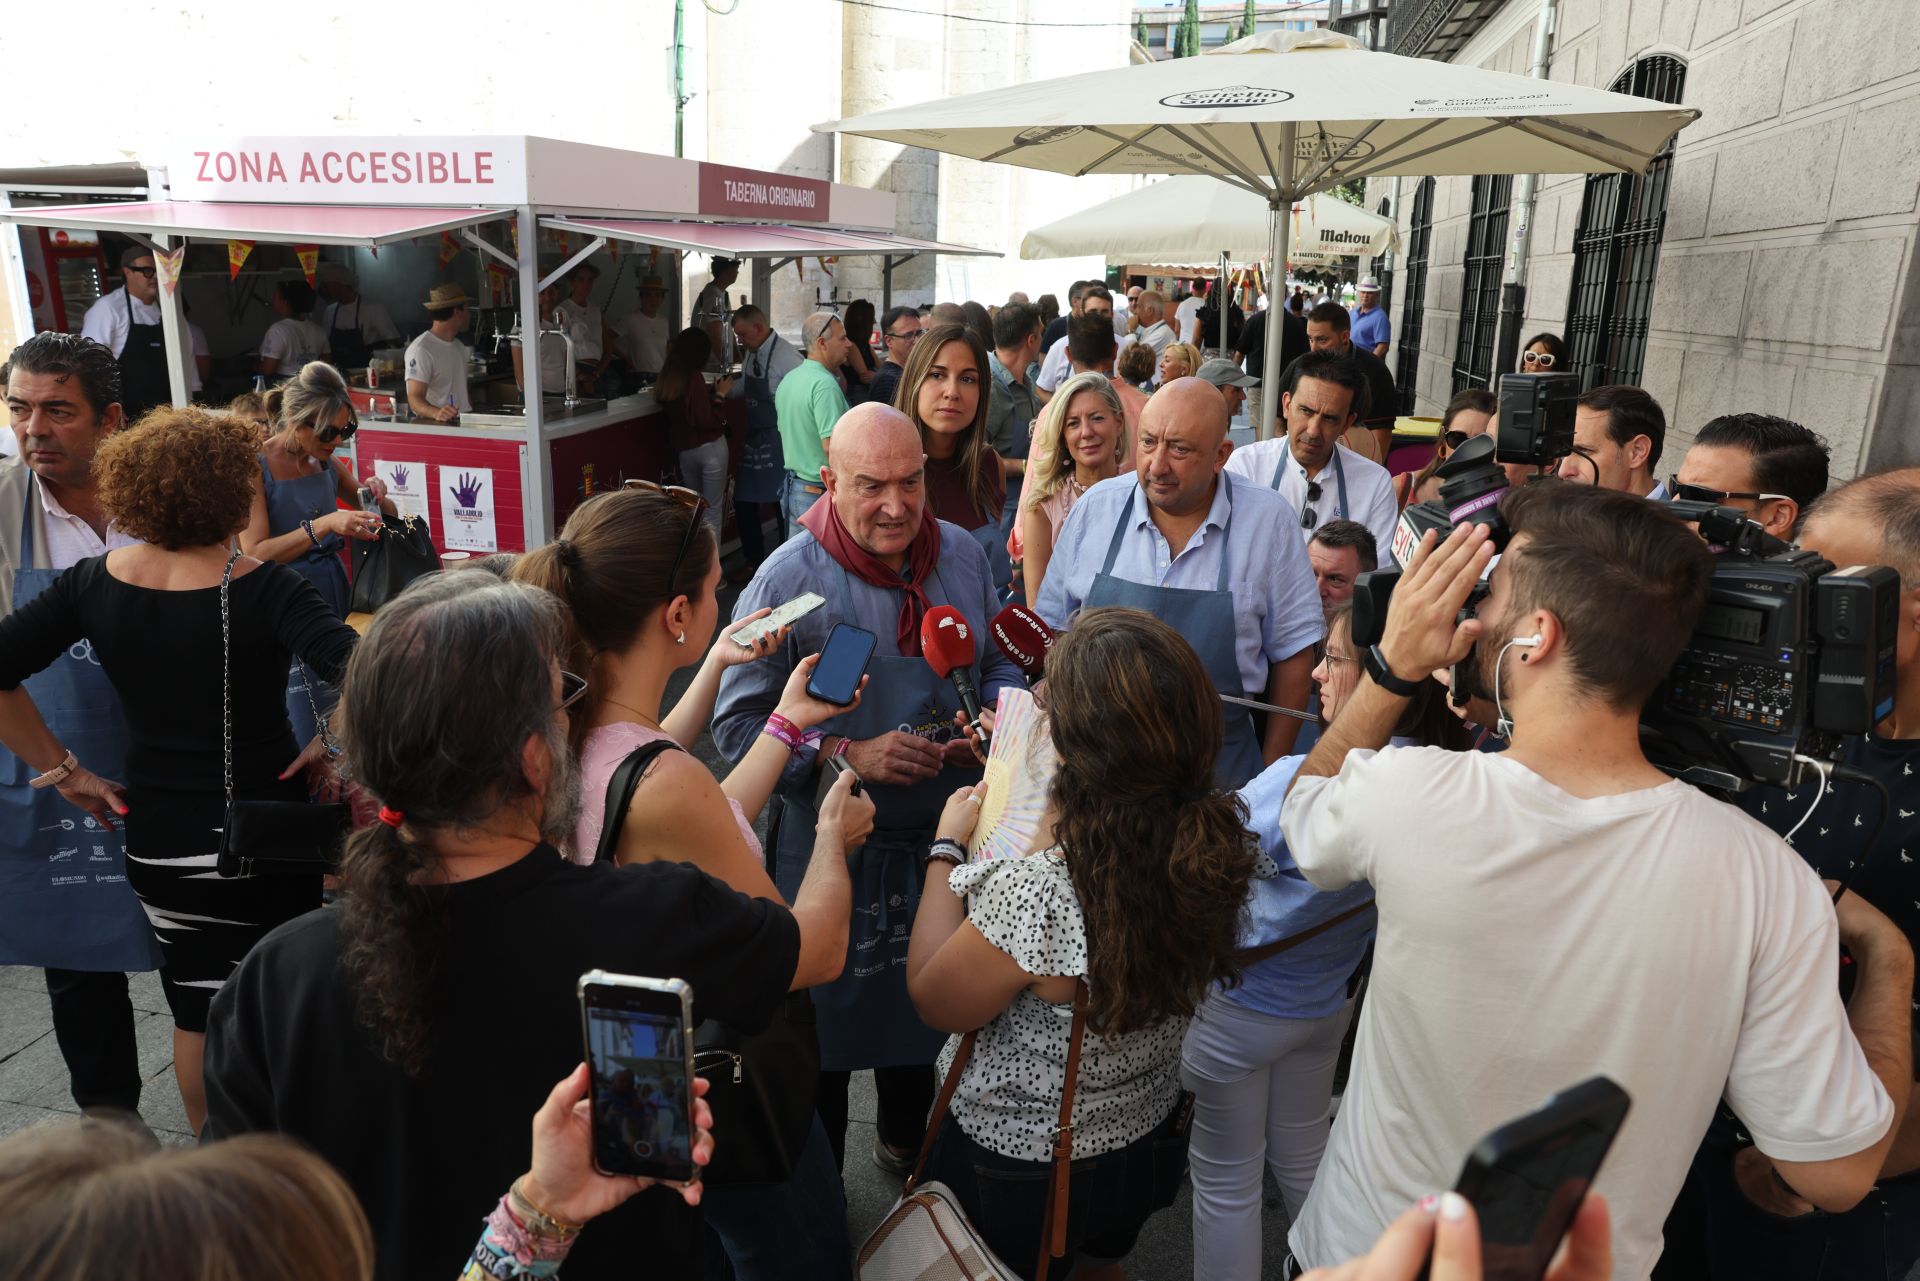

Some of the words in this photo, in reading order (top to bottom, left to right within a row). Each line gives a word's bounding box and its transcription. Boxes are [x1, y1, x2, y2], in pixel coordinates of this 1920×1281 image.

[193, 151, 288, 183] ZONA
[299, 151, 495, 184] ACCESIBLE
[724, 180, 768, 205] TABERNA
[768, 186, 816, 209] ORIGINARIO
[1320, 229, 1371, 244] Mahou
[1012, 608, 1047, 639] esRadio
[995, 623, 1026, 660] esRadio
